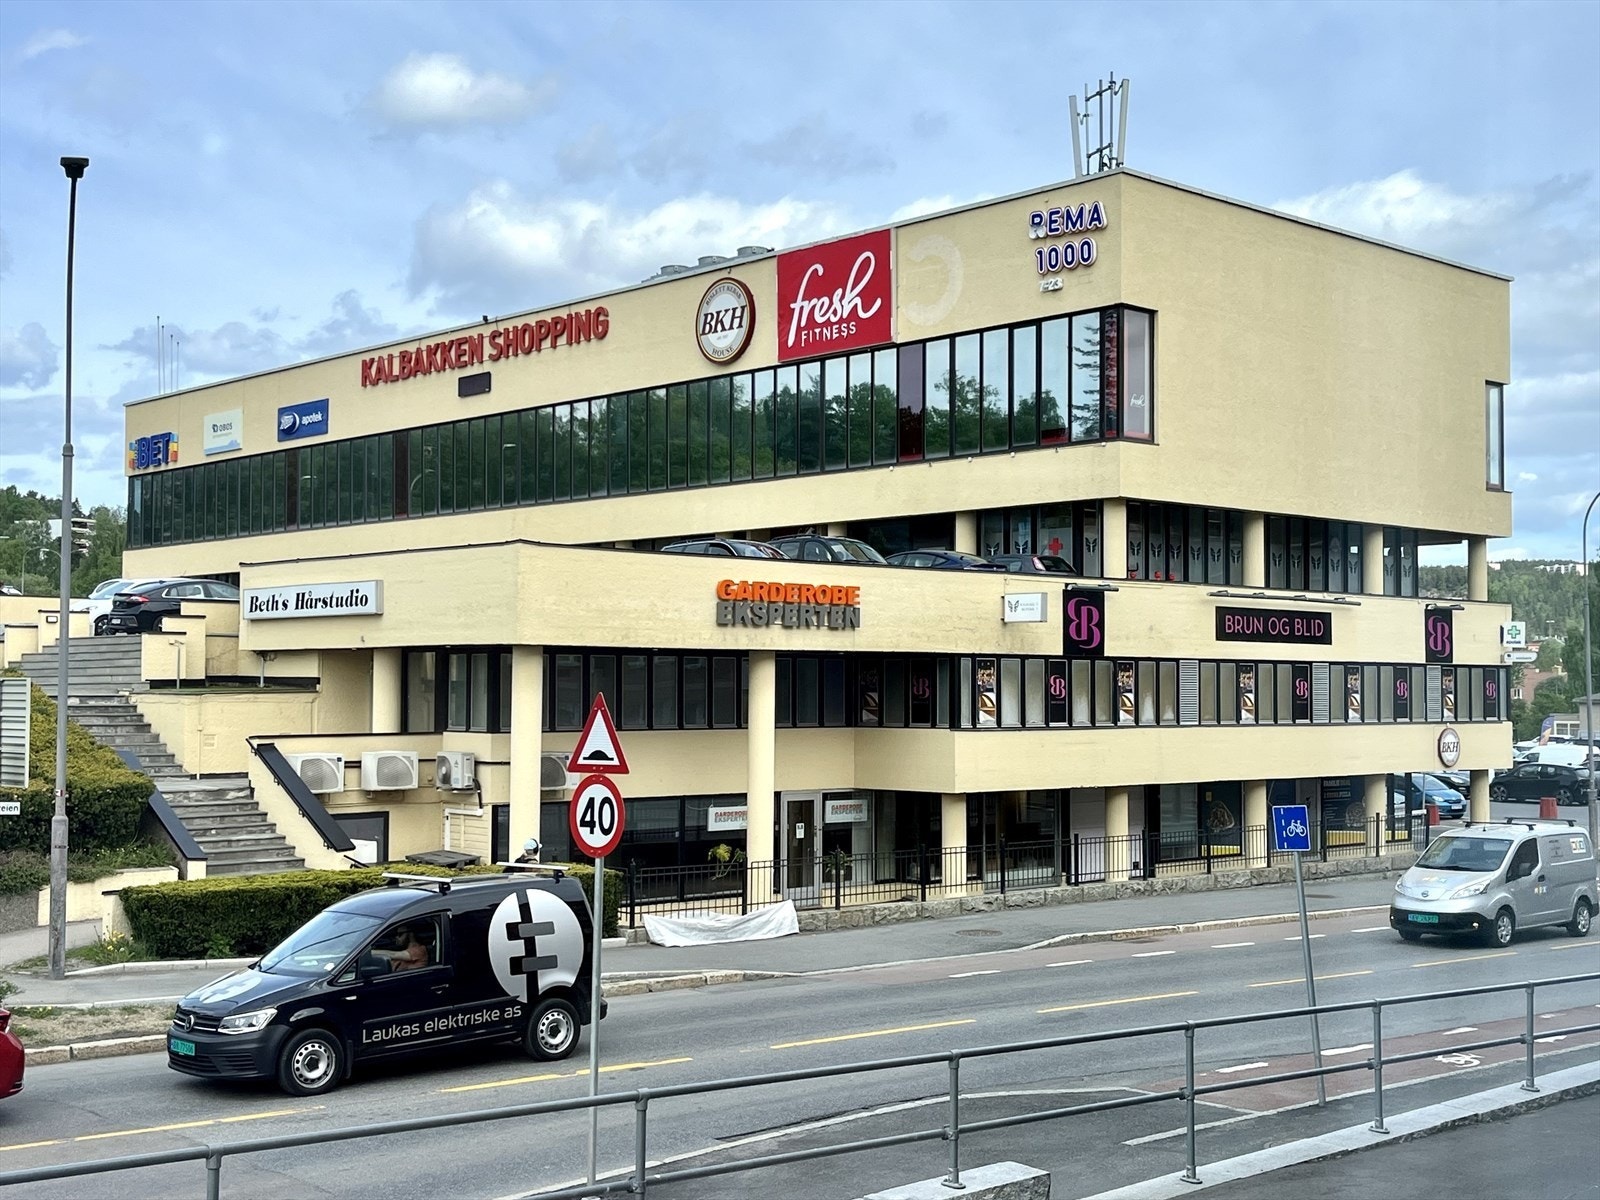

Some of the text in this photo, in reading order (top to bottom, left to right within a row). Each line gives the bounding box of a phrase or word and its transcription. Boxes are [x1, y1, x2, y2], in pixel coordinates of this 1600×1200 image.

[1029, 201, 1107, 239] REMA
[1035, 237, 1097, 274] 1000
[788, 251, 881, 347] fresh
[700, 304, 747, 336] BKH
[801, 322, 856, 347] FITNESS
[361, 306, 609, 387] KALBAKKEN SHOPPING
[712, 346, 734, 356] HOUSE
[301, 411, 323, 426] apotek
[137, 432, 171, 469] BET
[294, 588, 369, 611] Hårstudio
[716, 579, 860, 605] GARDEROBE
[716, 601, 861, 629] EKSPERTEN
[1225, 615, 1324, 636] BRUN OG BLID
[1441, 741, 1459, 753] BKH
[580, 796, 616, 836] 40
[362, 1005, 522, 1044] Laukas elektriske as
